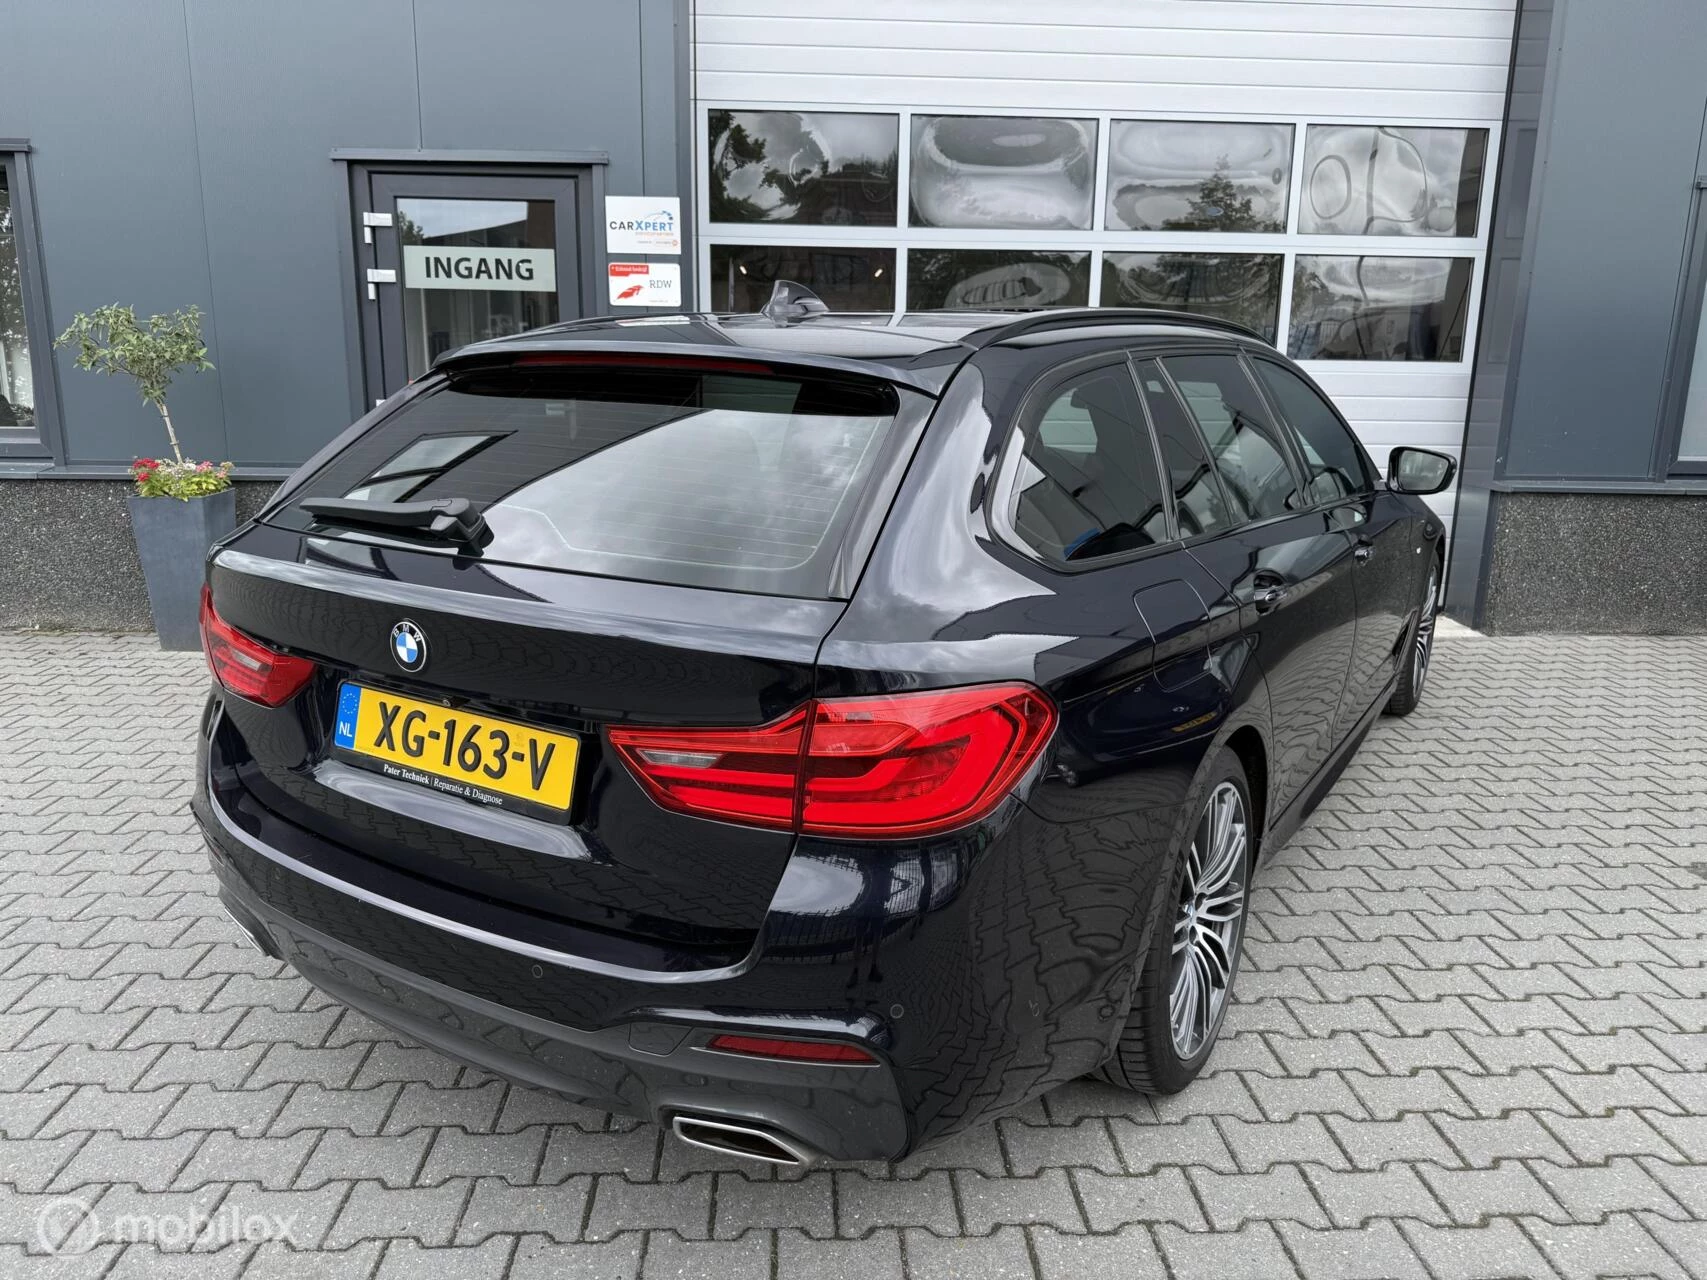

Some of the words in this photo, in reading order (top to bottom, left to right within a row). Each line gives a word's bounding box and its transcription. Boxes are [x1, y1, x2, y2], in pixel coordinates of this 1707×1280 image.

[609, 220, 673, 231] CARXPERT
[425, 256, 534, 281] INGANG
[649, 280, 672, 288] RDW
[393, 623, 422, 641] BMW
[338, 721, 353, 738] NL
[374, 701, 556, 791] XG-163-V
[383, 764, 401, 776] Pater
[401, 768, 430, 784] Techniek
[434, 778, 463, 794] Reparatie
[464, 787, 471, 796] &
[472, 788, 503, 805] Diagnose
